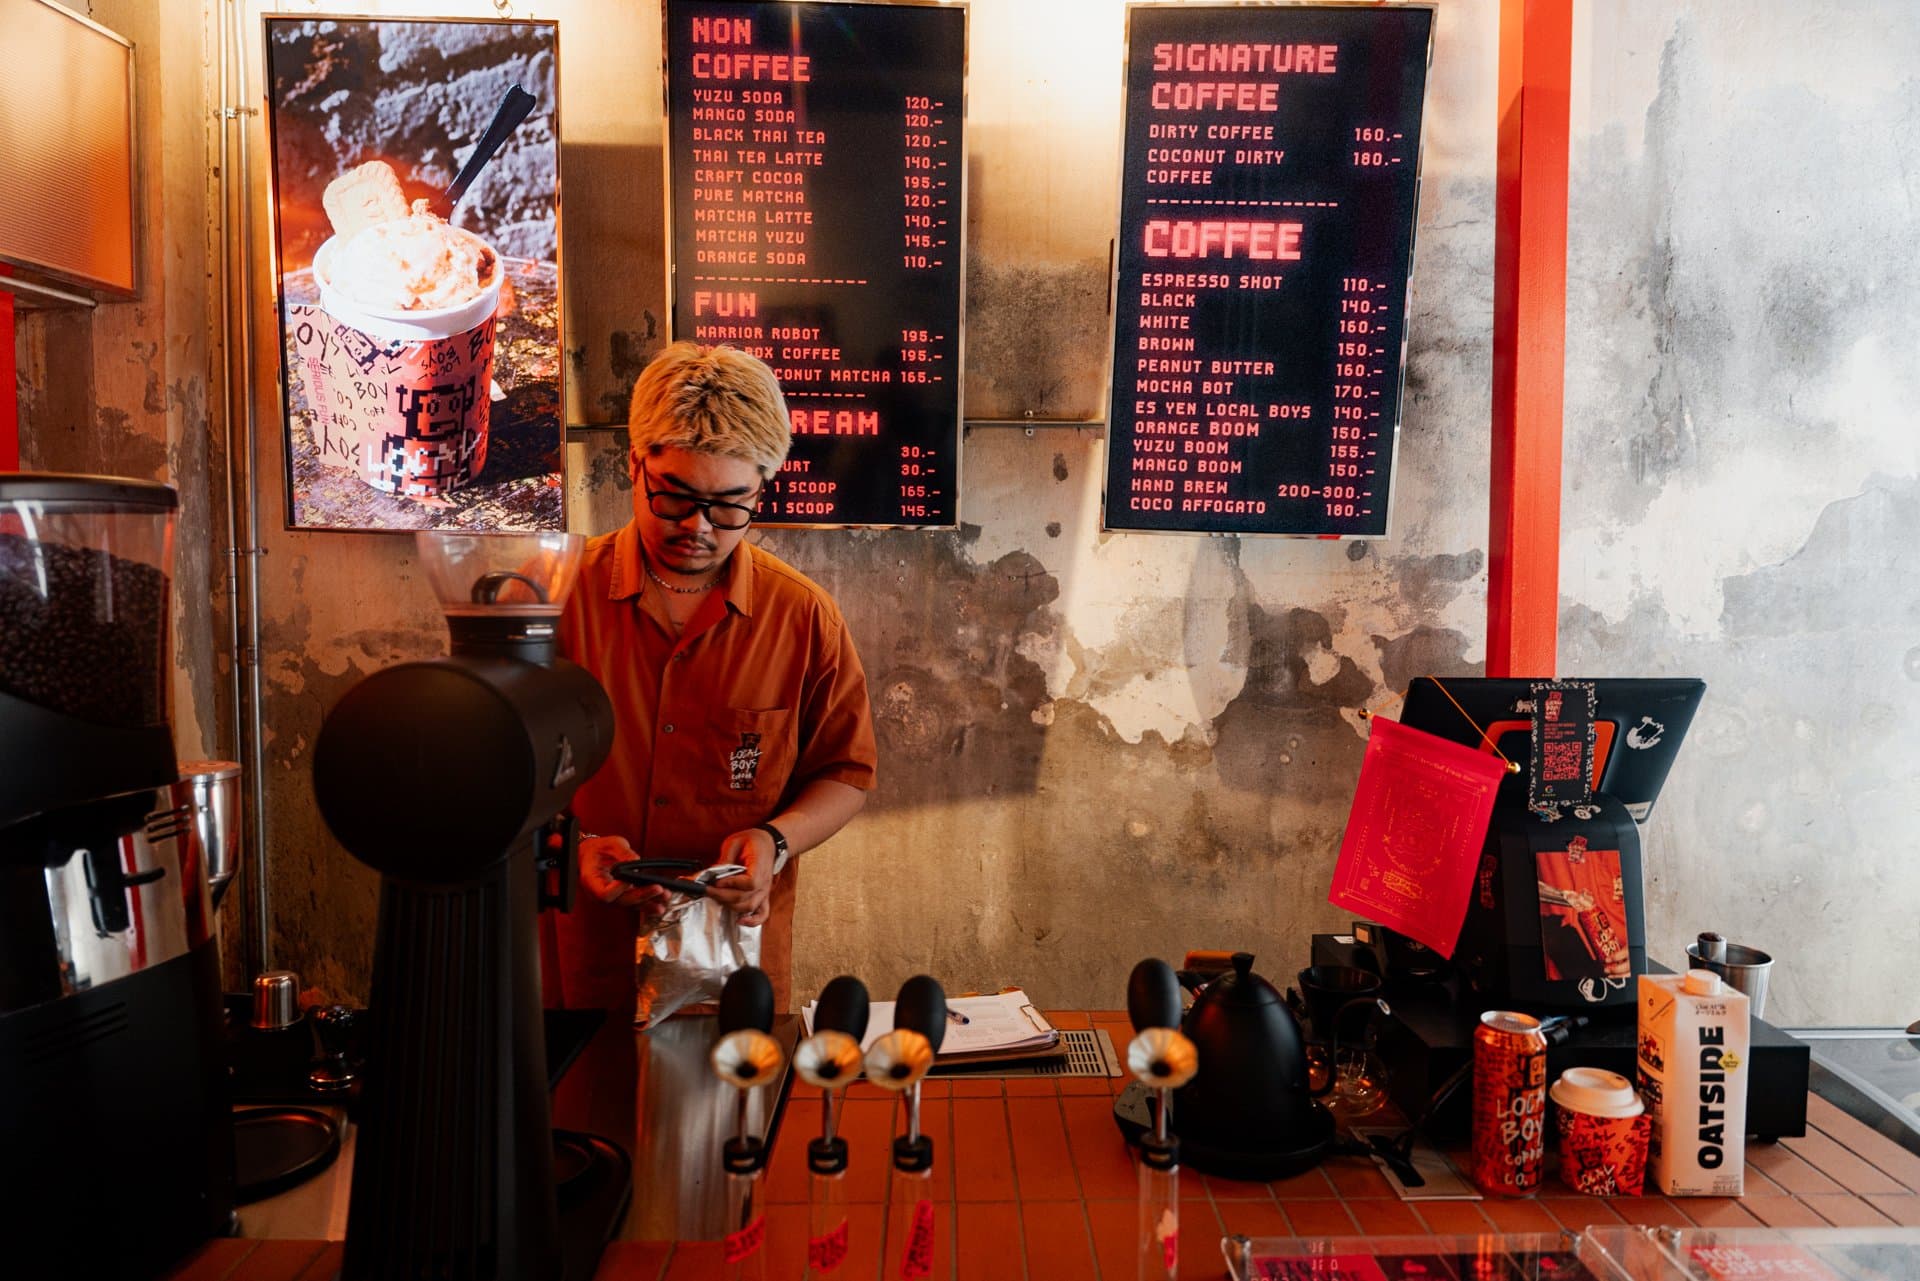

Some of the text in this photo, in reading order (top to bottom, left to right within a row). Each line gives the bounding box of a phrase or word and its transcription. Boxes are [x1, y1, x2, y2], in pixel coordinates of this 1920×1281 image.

[692, 18, 752, 44] NON
[1153, 44, 1337, 73] SIGNATURE
[692, 54, 810, 82] COFFEE
[694, 90, 943, 110] YUZU SODA 120.-
[1152, 83, 1279, 111] COFFEE
[693, 109, 942, 128] MANGO SODA 120.-
[693, 128, 947, 147] BLACK THAI TEA 120.-
[1150, 125, 1403, 142] DIRTY COFFEE 160.-
[694, 150, 947, 169] THAI TEA LATTE 140.-
[1148, 149, 1400, 166] COCONUT DIRTY 180.-
[695, 170, 946, 189] CRAFT COCOA 195.-
[1147, 171, 1212, 184] COFFEE
[694, 190, 946, 207] PURE MATCHA 120.-
[695, 210, 946, 228] MATCHA LATTE 140.-
[696, 230, 946, 248] MATCHA YUZU 145.-
[1144, 221, 1303, 260] COFFEE
[697, 250, 942, 268] ORANGE SODA 110.-
[1142, 274, 1386, 291] ESPRESSO SHOT 110.-
[694, 292, 756, 318] FUN
[1141, 293, 1388, 313] BLACK 140.-
[1139, 316, 1386, 333] WHITE 160.-
[696, 326, 944, 342] WARRIOR ROBOT 195.-
[782, 348, 840, 360] COFFEE
[901, 350, 942, 362] 195.-
[1139, 338, 1384, 356] BROWN 150.-
[831, 370, 890, 382] MATCHA
[901, 371, 942, 383] 165.-
[1138, 360, 1383, 376] PEANUT BUTTER 160.-
[1137, 380, 1380, 399] MOCHA BOT 170.-
[1136, 401, 1380, 419] ES YEN LOCAL BOYS 140.-
[1135, 422, 1378, 439] ORANGE BOOM 150.-
[901, 446, 936, 458] 30.-
[1134, 440, 1376, 458] YUZU BOOM 155.-
[901, 464, 935, 476] 30.-
[1132, 459, 1374, 477] MANGO BOOM 150.-
[775, 482, 780, 493] 1
[788, 482, 837, 494] SCOOP
[901, 486, 940, 498] 165.-
[1132, 479, 1372, 499] HAND BREW 200-300.-
[772, 502, 777, 514] 1
[786, 502, 834, 514] SCOOP
[901, 506, 940, 517] 145.-
[1131, 497, 1371, 517] COCO AFFOGATO 180.-
[730, 746, 764, 761] LOCAL
[730, 758, 758, 773] BOYS
[1697, 1026, 1726, 1170] OATSIDE
